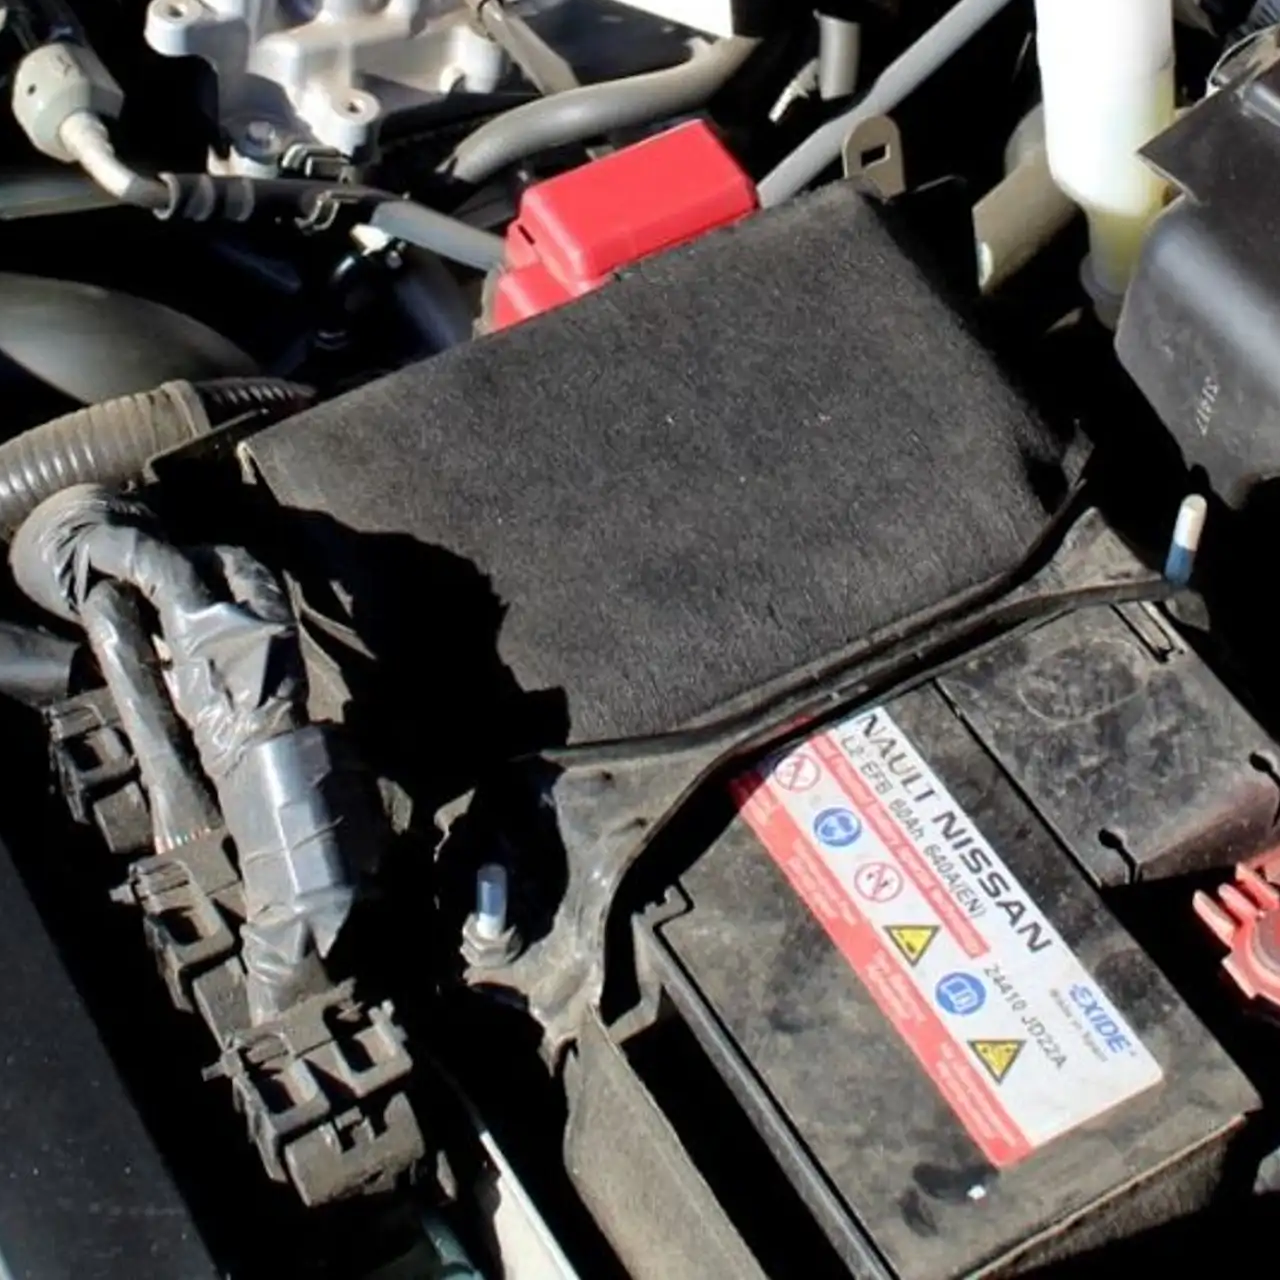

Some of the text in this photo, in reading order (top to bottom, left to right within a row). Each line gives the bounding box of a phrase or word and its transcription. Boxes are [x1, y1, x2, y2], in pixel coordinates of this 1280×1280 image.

[922, 843, 987, 918] 640A(EN)
[932, 810, 1052, 954] NISSAN
[982, 963, 1028, 1013] 24410
[1068, 983, 1132, 1054] EXIDE
